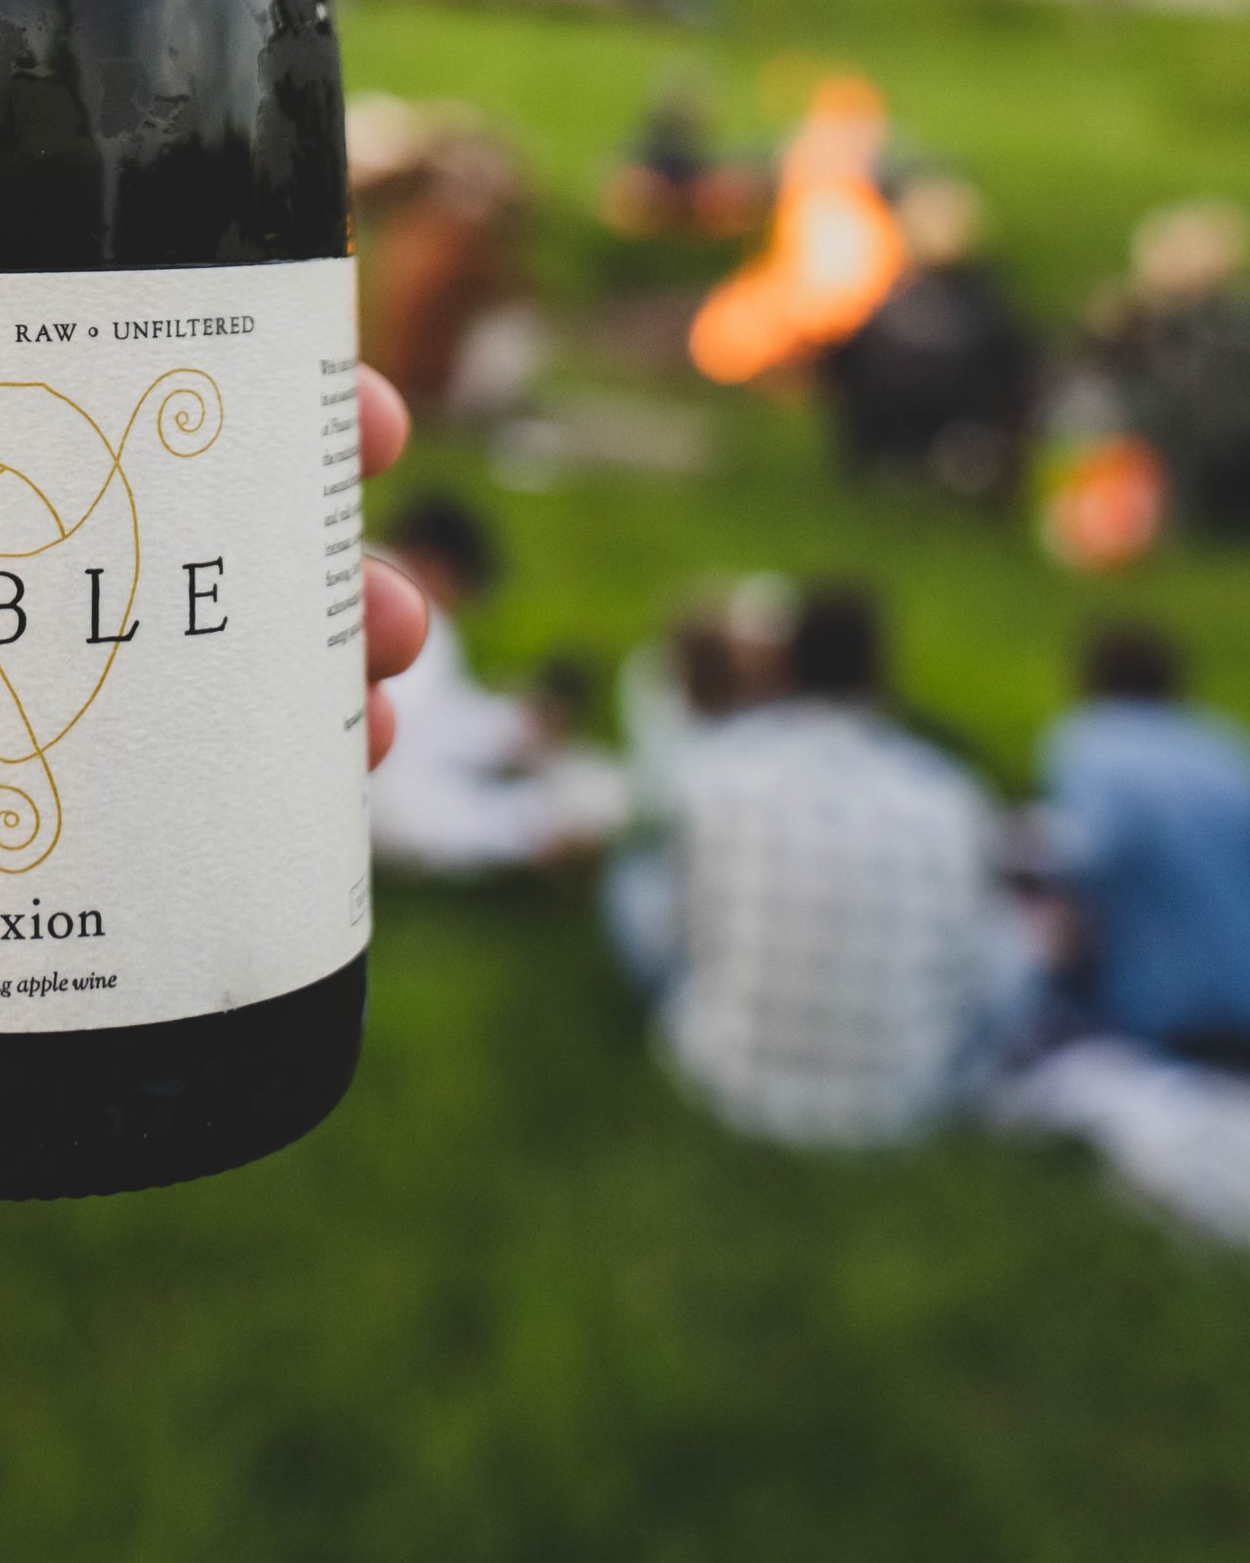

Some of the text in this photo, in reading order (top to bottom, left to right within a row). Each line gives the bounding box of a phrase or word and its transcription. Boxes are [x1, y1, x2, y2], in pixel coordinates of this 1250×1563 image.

[15, 323, 77, 342] RAW
[113, 315, 255, 340] UNFILTERED
[17, 970, 69, 998] apple
[72, 972, 118, 990] wine
